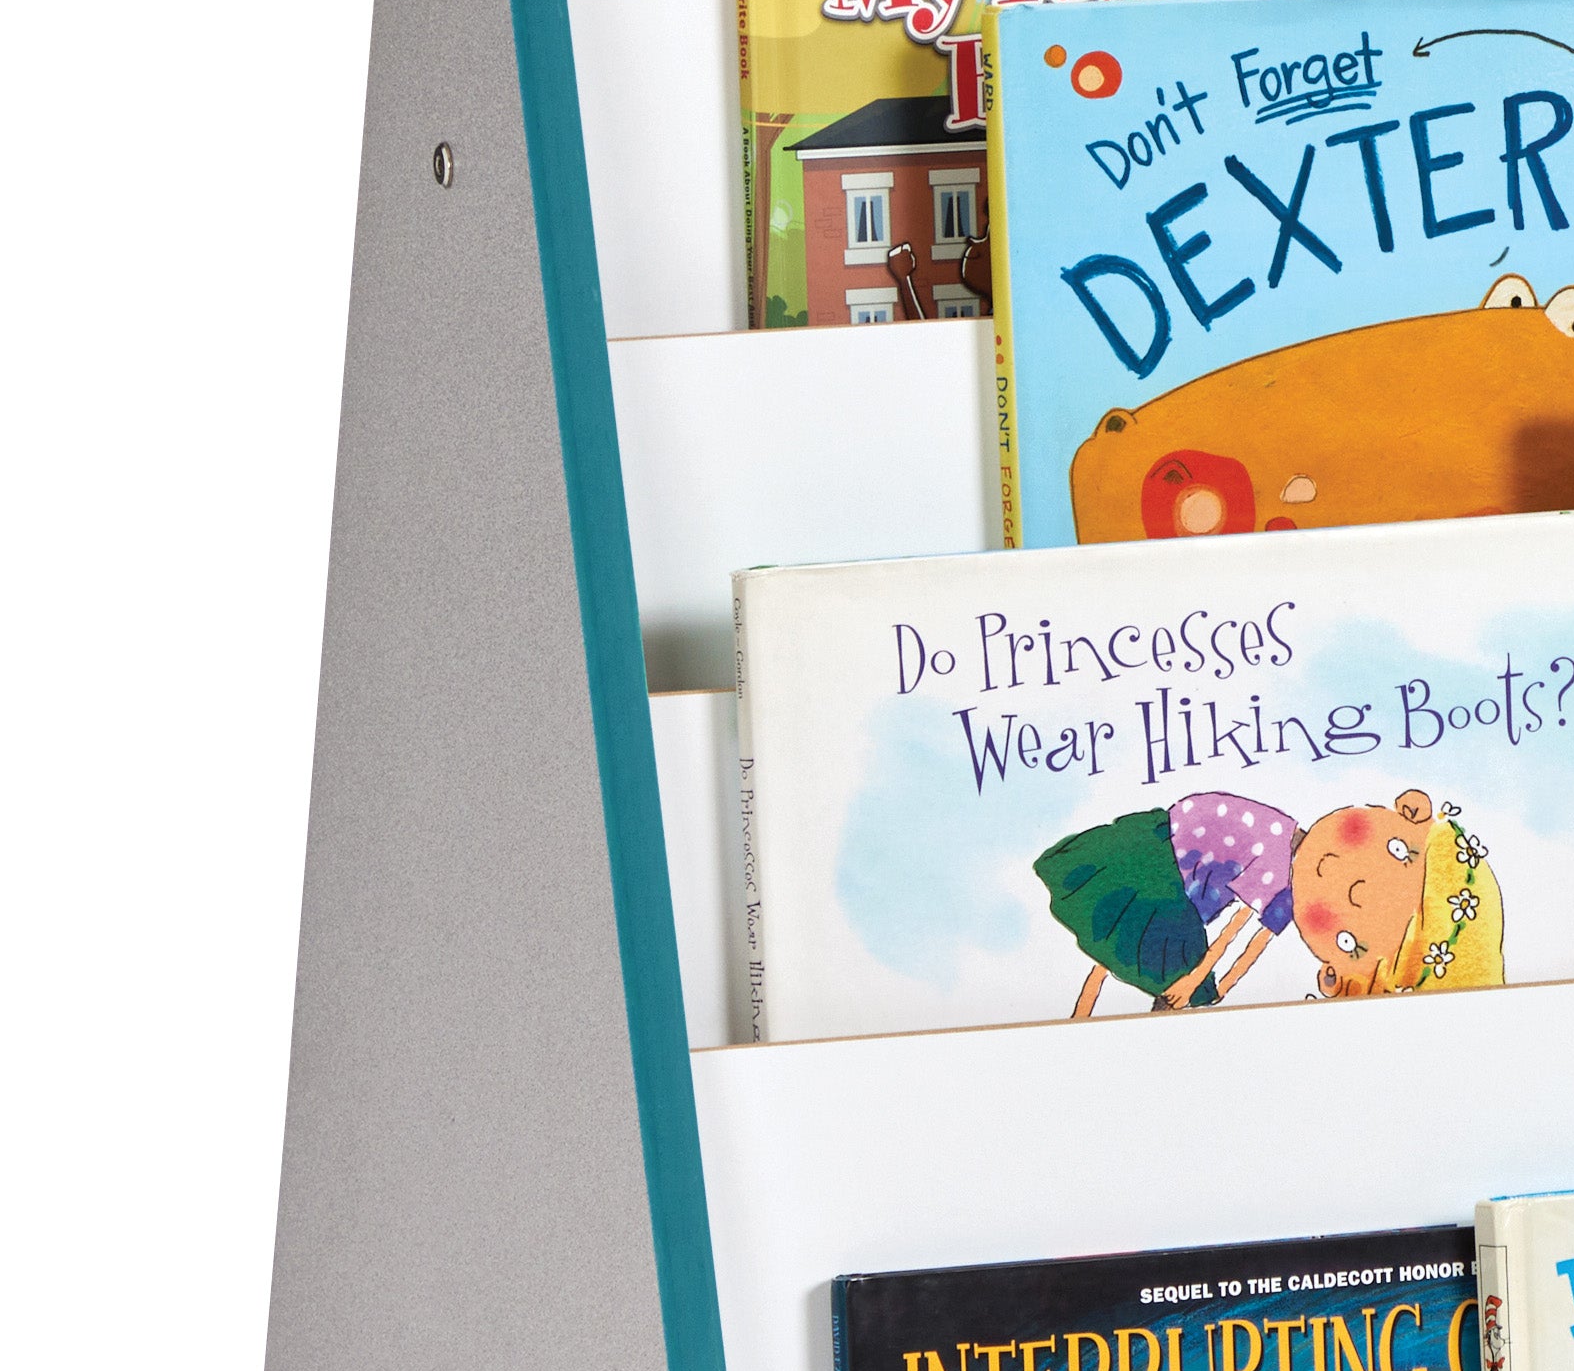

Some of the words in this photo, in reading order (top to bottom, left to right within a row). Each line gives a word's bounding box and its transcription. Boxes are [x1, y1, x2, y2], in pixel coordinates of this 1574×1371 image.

[739, 34, 750, 80] Book
[983, 53, 993, 111] WARD
[1085, 80, 1208, 190] Don't
[1231, 31, 1383, 110] Forget
[996, 376, 1010, 453] DON'T
[892, 623, 957, 696] Do
[974, 600, 1297, 695] Princesses
[739, 757, 754, 780] Do
[952, 708, 1115, 798] Wear
[1136, 687, 1383, 786] Hiking
[1140, 1285, 1213, 1304] SEQUEL
[1218, 1280, 1242, 1297] TO
[1248, 1277, 1282, 1295] THE
[1287, 1267, 1394, 1291] CALDECOTT
[1399, 1261, 1465, 1282] HONOR
